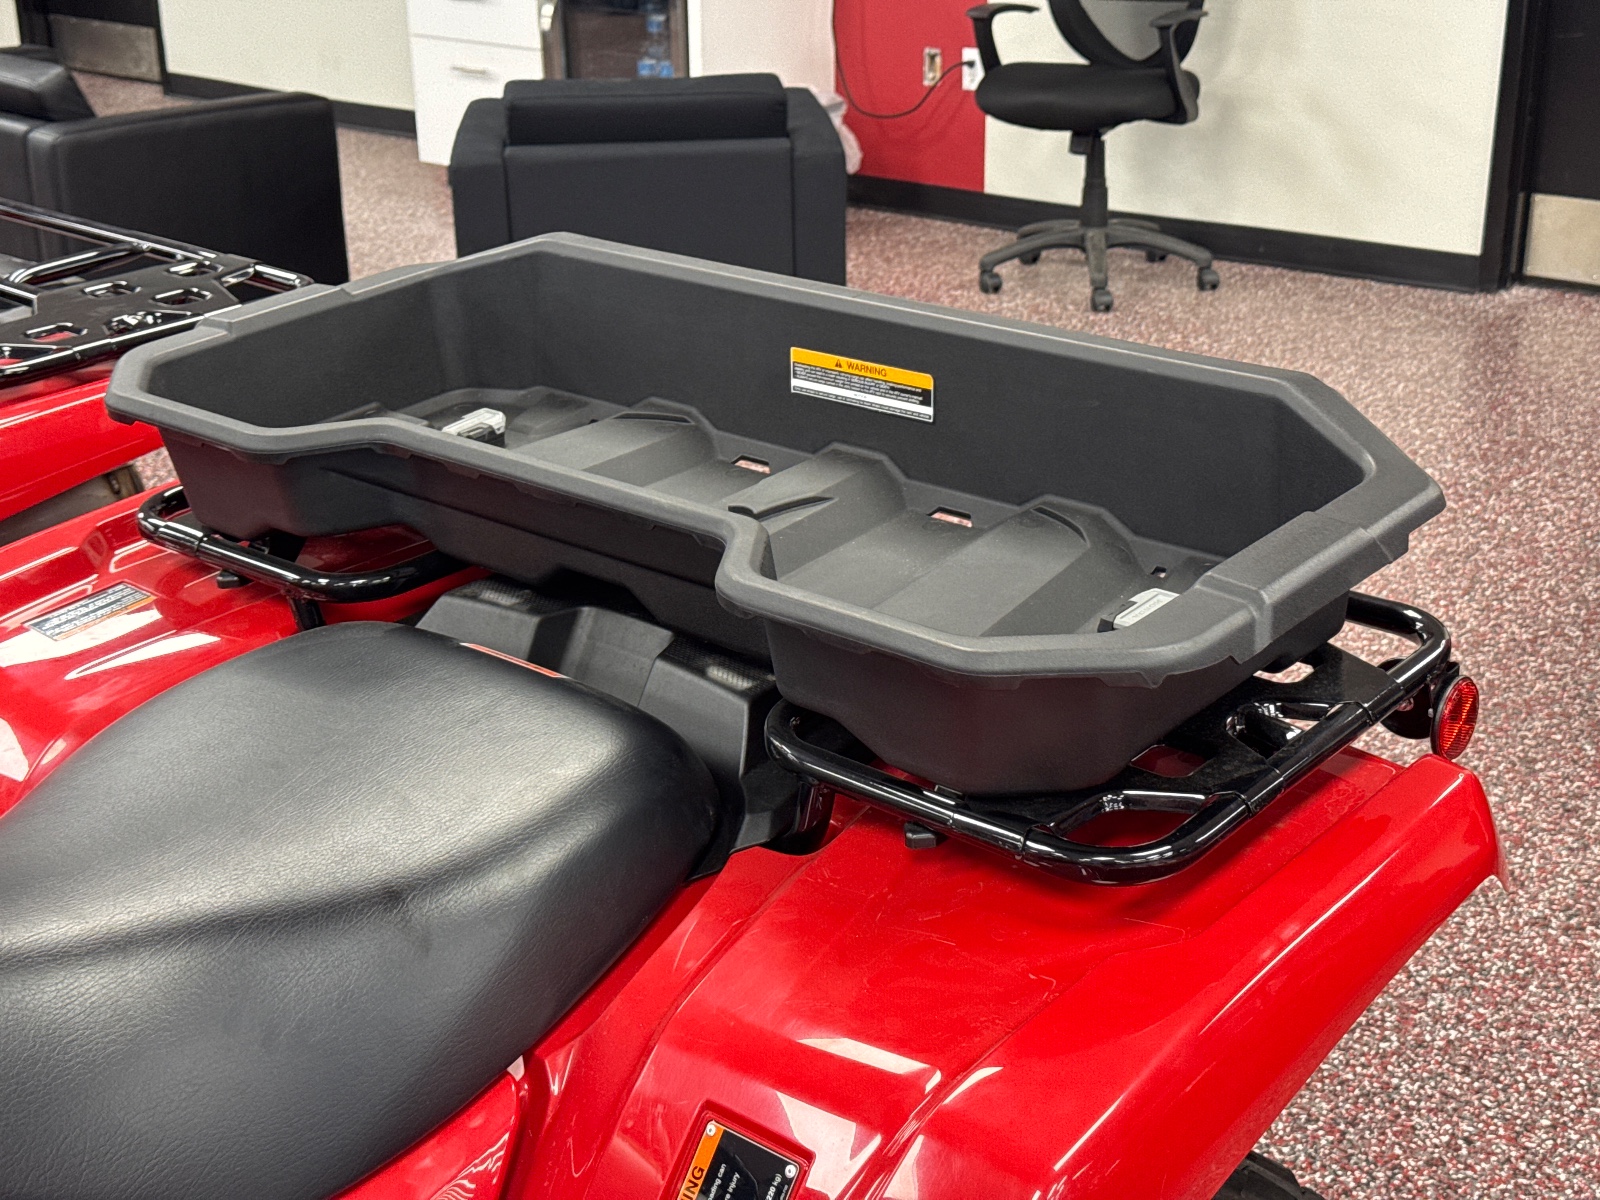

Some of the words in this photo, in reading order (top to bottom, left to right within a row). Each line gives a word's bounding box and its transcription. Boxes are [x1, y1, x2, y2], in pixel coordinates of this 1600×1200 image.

[847, 361, 887, 377] WARNING
[718, 1164, 727, 1177] can
[682, 1166, 705, 1200] ING
[727, 1172, 740, 1192] injury
[765, 1186, 776, 1200] 220
[772, 1174, 782, 1186] kg)
